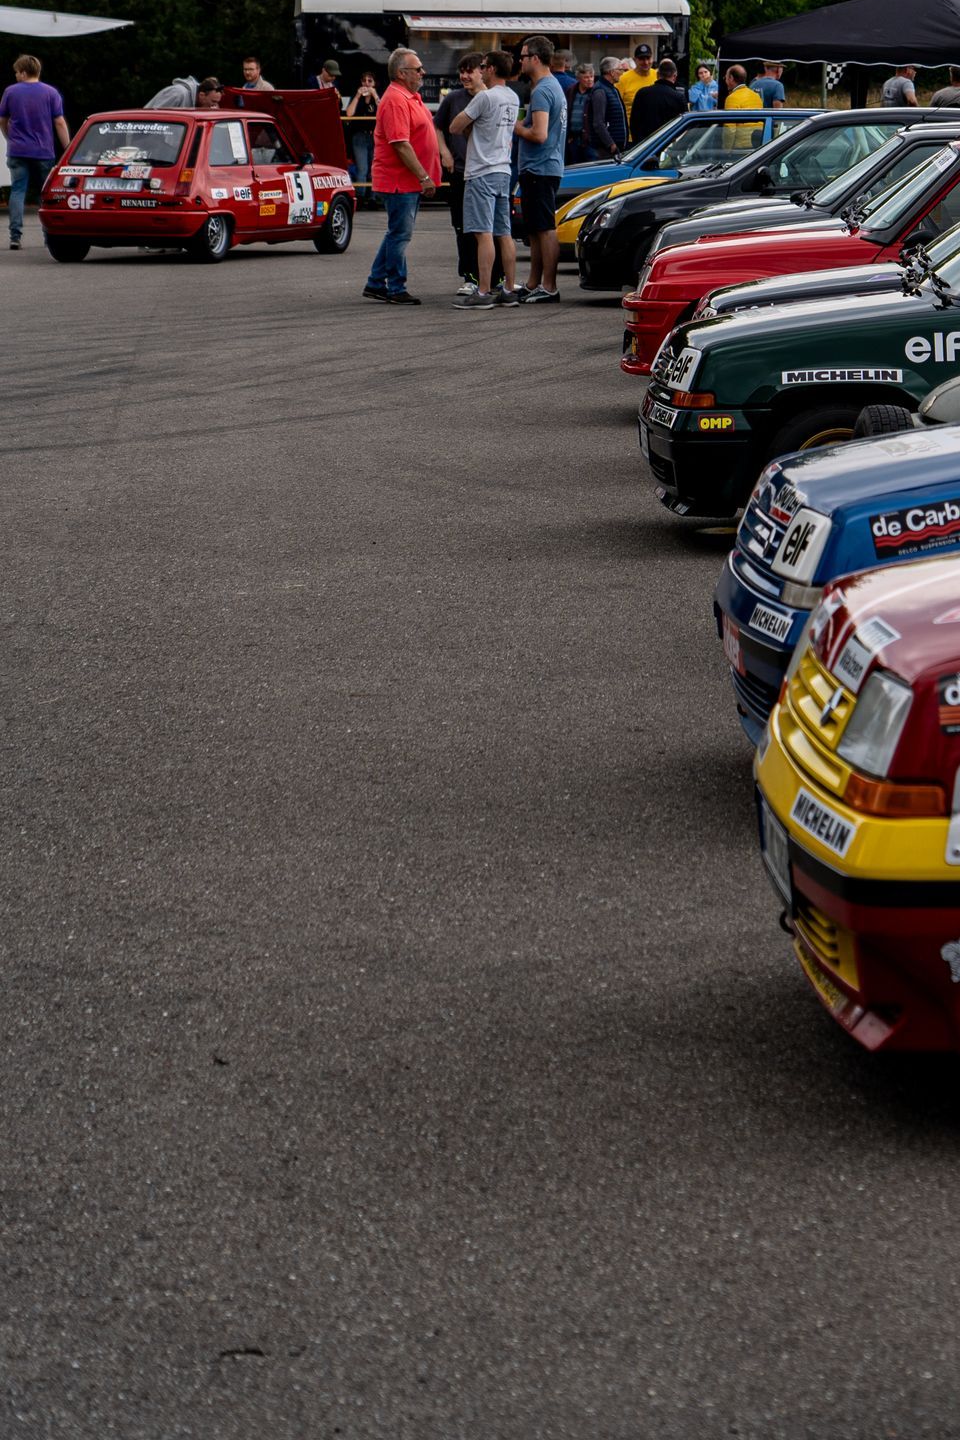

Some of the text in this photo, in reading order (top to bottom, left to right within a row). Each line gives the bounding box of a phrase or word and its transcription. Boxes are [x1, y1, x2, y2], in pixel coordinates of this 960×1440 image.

[114, 123, 169, 132] Schroeder
[85, 179, 141, 190] RENAULT
[294, 173, 304, 200] 5
[312, 176, 343, 189] RENAULT
[67, 194, 95, 209] elf
[241, 190, 251, 199] elf
[121, 199, 157, 208] RENAULT
[671, 355, 693, 383] elf
[787, 368, 898, 383] MICHELIN
[700, 417, 732, 429] OMP
[872, 516, 902, 537] de
[782, 521, 817, 567] elf
[920, 539, 956, 551] SUSPENSION
[750, 607, 790, 638] MICHELIN
[792, 793, 851, 853] MICHELIN
